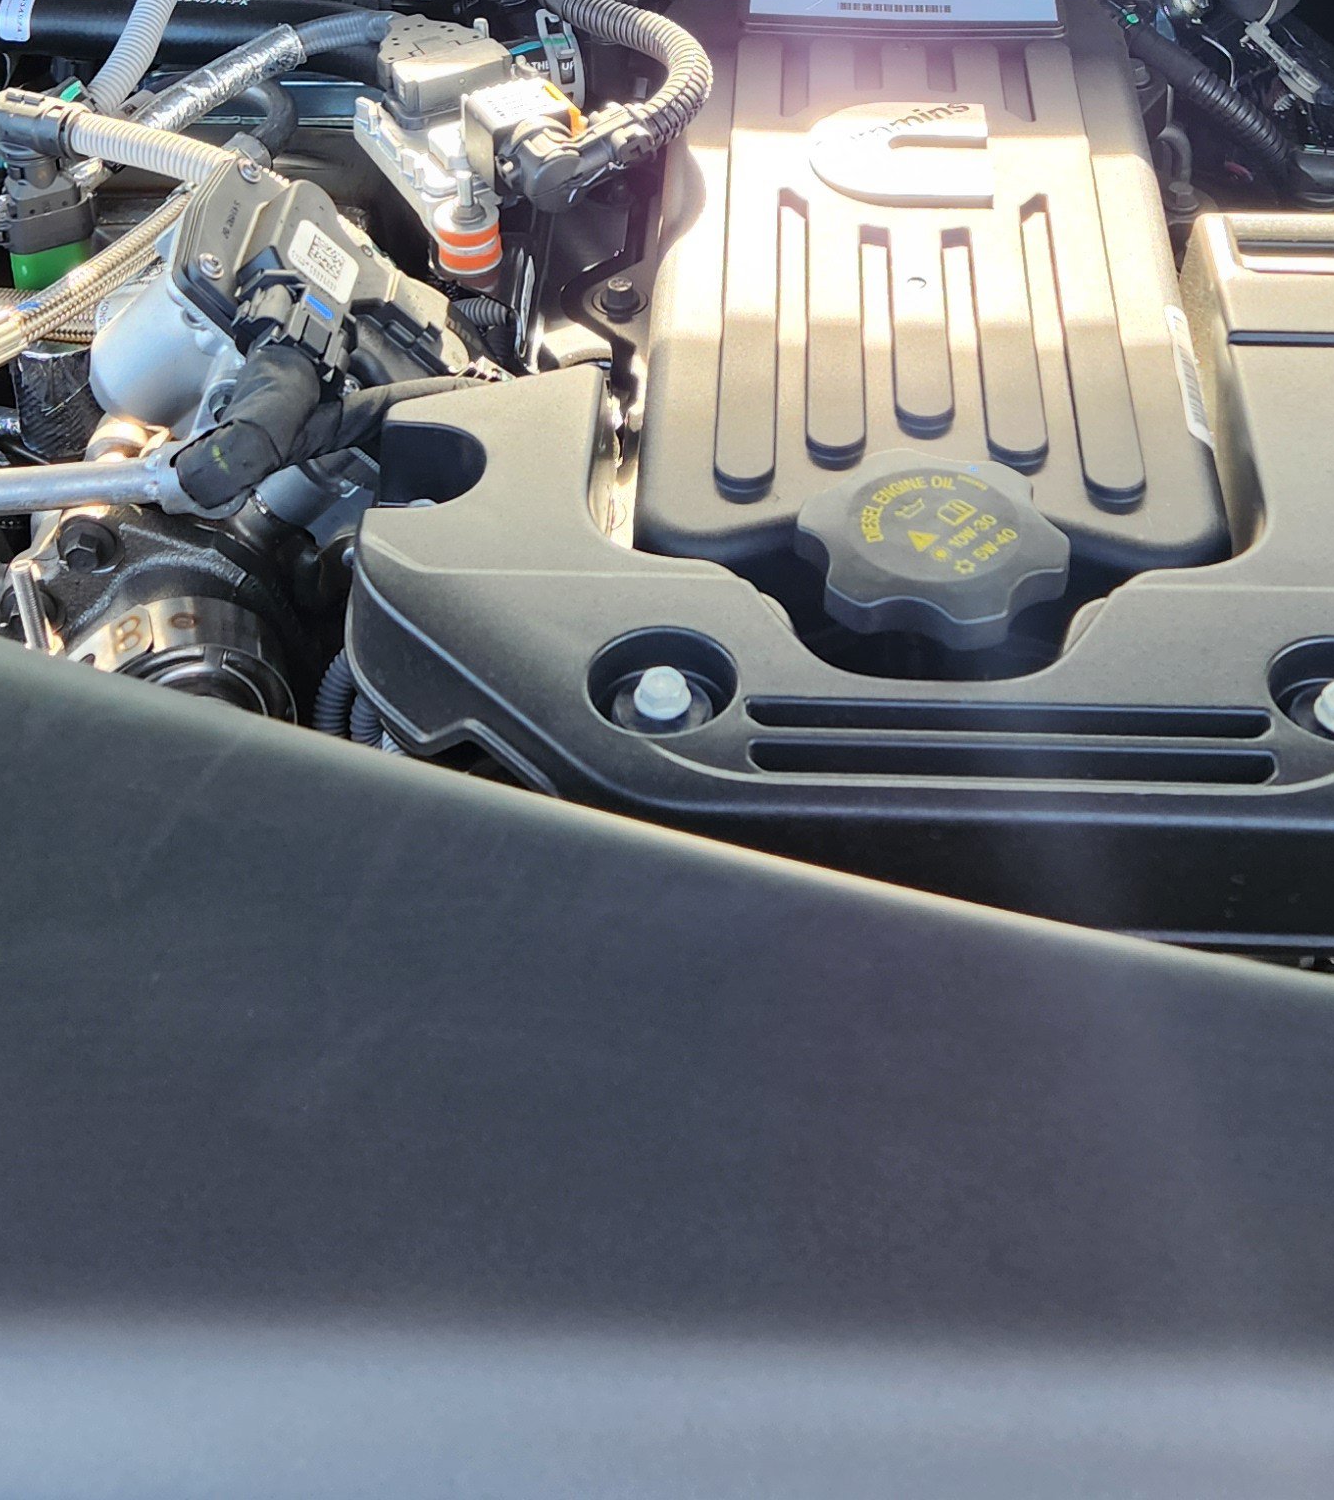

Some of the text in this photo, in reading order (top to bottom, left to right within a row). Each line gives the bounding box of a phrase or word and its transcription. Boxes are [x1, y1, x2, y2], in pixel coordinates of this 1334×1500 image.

[872, 476, 928, 505] ENGINE
[931, 475, 956, 490] OIL
[861, 505, 884, 543] DIESEL
[949, 514, 997, 548] 10W-30
[972, 528, 1017, 561] 5W-40
